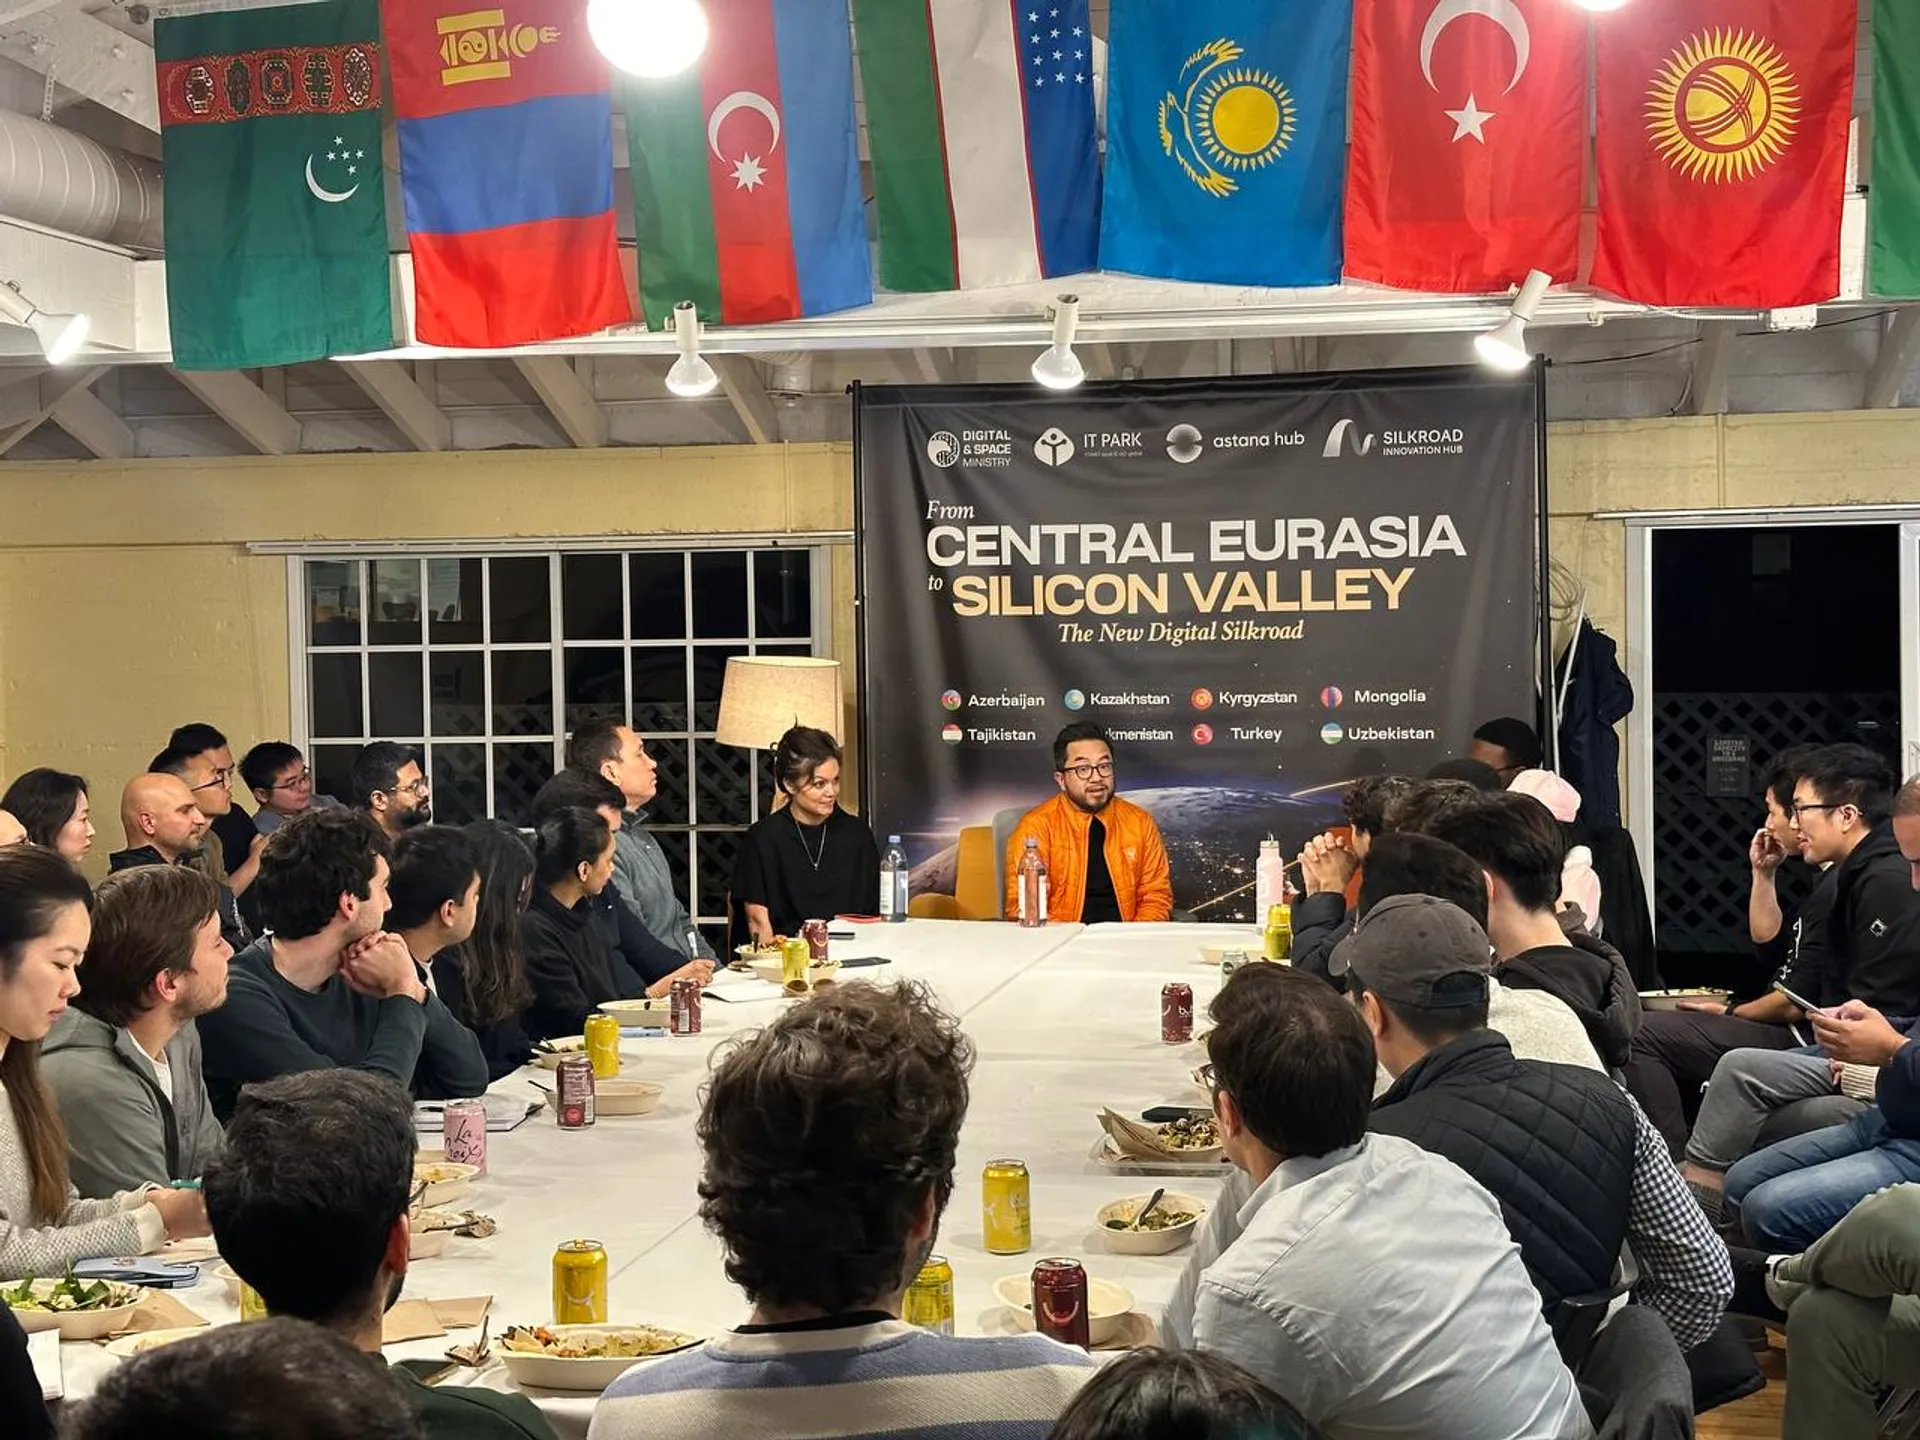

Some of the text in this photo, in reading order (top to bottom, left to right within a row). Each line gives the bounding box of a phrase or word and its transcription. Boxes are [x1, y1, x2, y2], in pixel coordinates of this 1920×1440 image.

[962, 430, 1012, 441] DIGITAL
[1084, 431, 1142, 448] IT PARK
[1213, 430, 1305, 448] astana hub
[1383, 428, 1464, 446] SILKROAD
[962, 443, 1012, 455] & SPACE
[1382, 442, 1464, 456] INNOVATION HUB
[962, 457, 1011, 468] MINISTRY
[926, 499, 975, 520] From
[927, 514, 1467, 567] CENTRAL EURASIA
[928, 574, 944, 591] to
[952, 567, 1416, 617] SILICON VALLEY
[1058, 619, 1305, 647] The New Digital Silkroad
[967, 693, 1046, 710] Azerbaijan
[1090, 691, 1170, 705] Kazakhstan
[1219, 691, 1298, 708] Kyrgyzstan
[1354, 688, 1427, 706] Mongolia
[967, 727, 1037, 745] Tajikistan
[1104, 727, 1174, 742] kmenistan
[1230, 726, 1283, 744] Turkey
[1348, 726, 1435, 741] Uzbekistan
[454, 1118, 472, 1145] La
